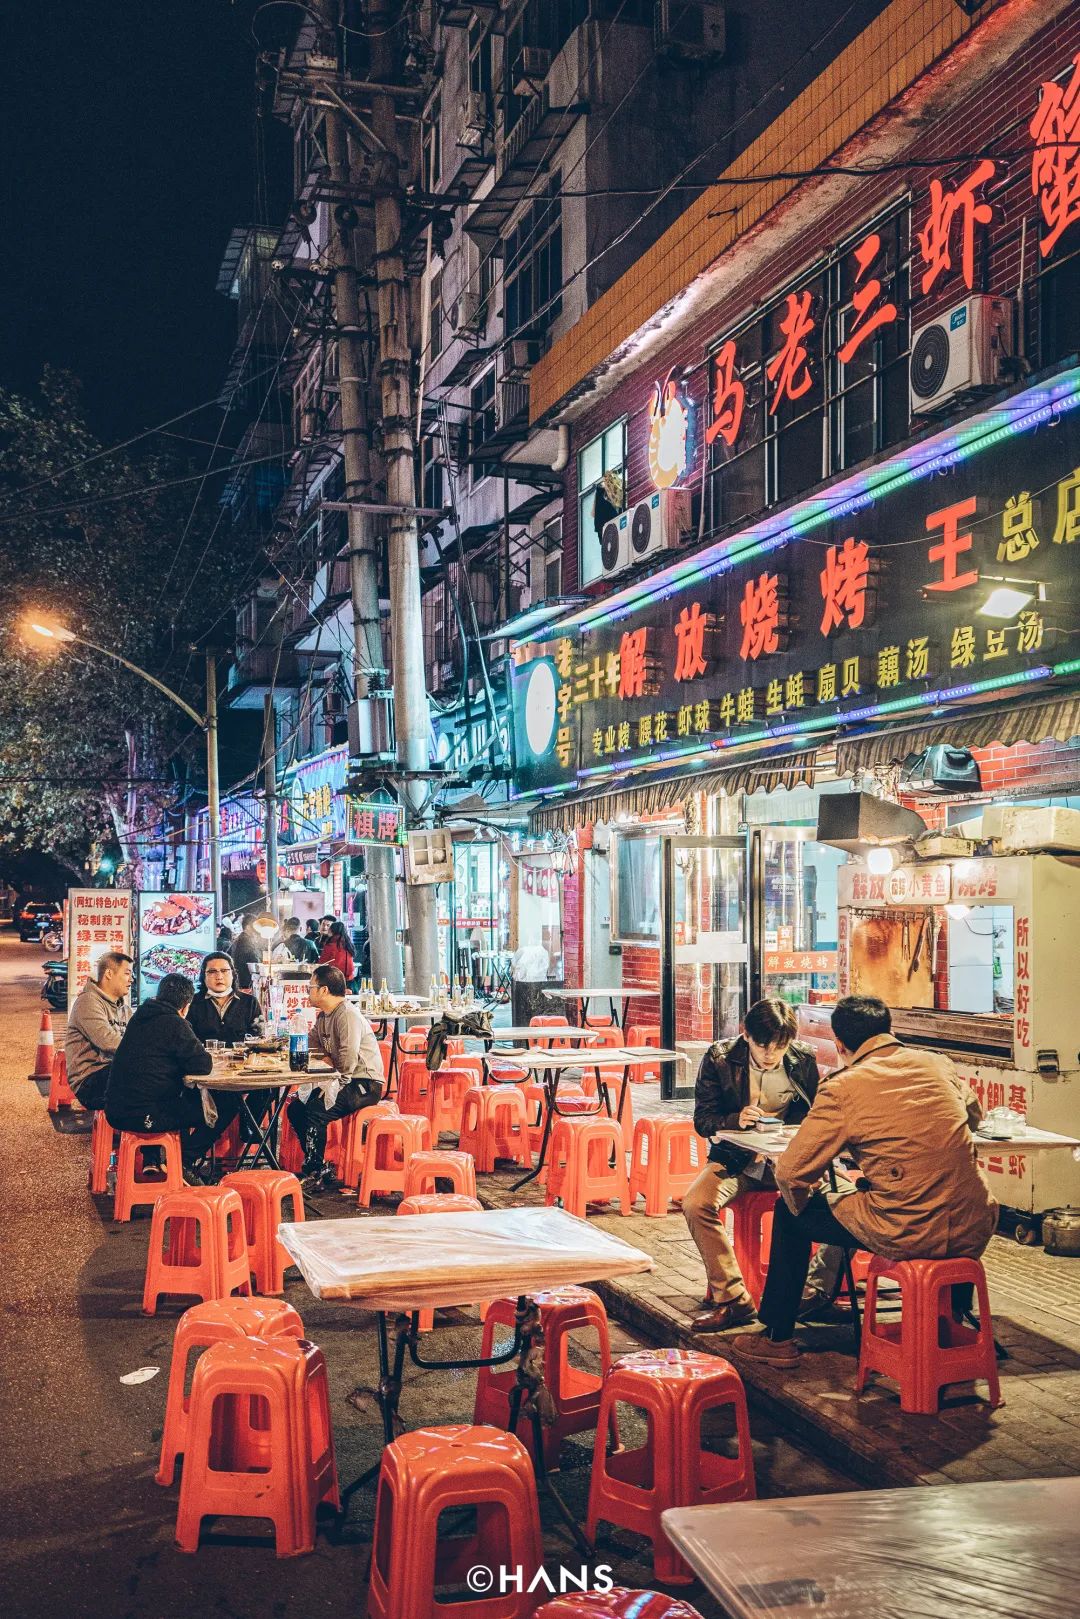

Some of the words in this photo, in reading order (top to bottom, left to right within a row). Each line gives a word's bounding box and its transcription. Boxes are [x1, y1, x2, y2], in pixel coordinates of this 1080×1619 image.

[619, 496, 978, 700] 解放烧烤王
[557, 637, 572, 767] 老字号
[677, 699, 710, 736] 虾球
[720, 687, 754, 726] 牛蛙
[766, 671, 804, 715] 生蚝
[817, 656, 860, 702] 扇贝
[878, 636, 929, 689] 藕汤
[951, 611, 1043, 669] 绿豆汤
[354, 809, 397, 840] 棋牌
[909, 874, 947, 897] 小黄鱼
[76, 930, 124, 942] 绿豆汤
[1016, 917, 1030, 1048] 所以好吃
